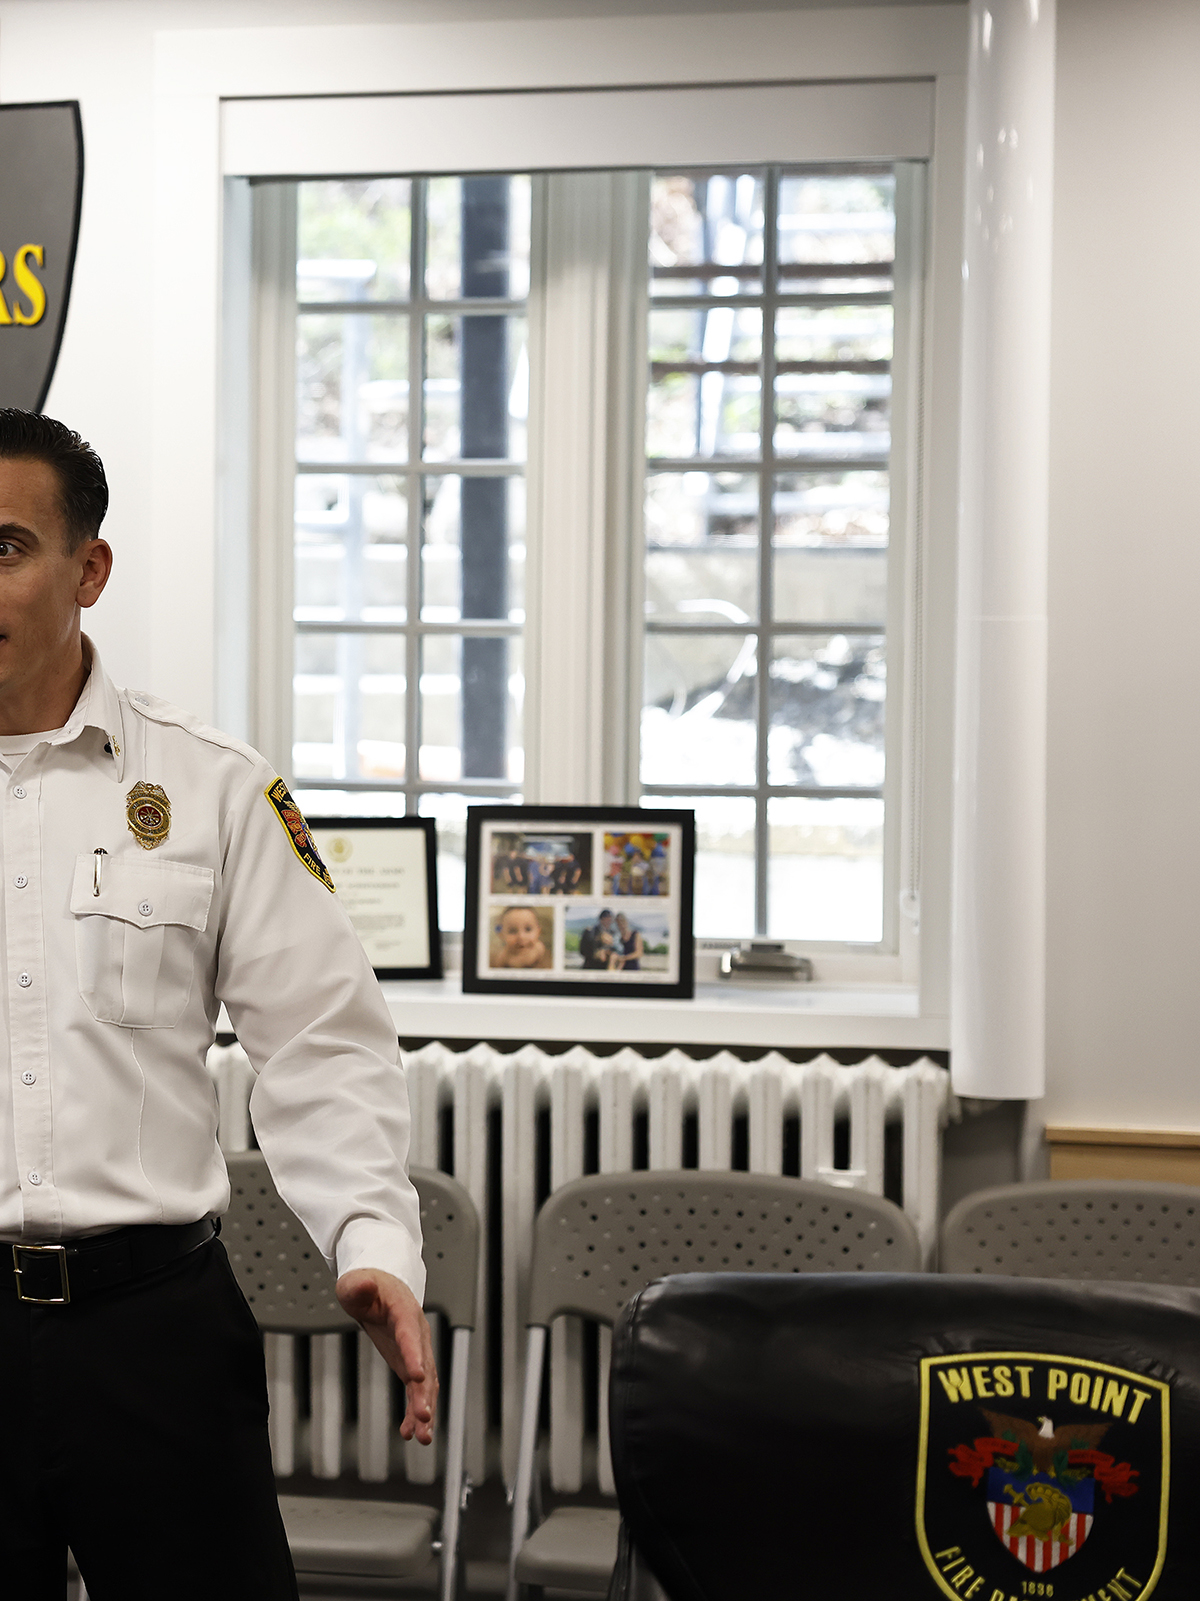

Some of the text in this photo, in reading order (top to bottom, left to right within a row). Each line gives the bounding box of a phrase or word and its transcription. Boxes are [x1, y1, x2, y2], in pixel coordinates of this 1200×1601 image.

[303, 852, 321, 876] FIRE
[937, 1365, 1152, 1425] WEST POINT
[934, 1545, 986, 1600] FIRE
